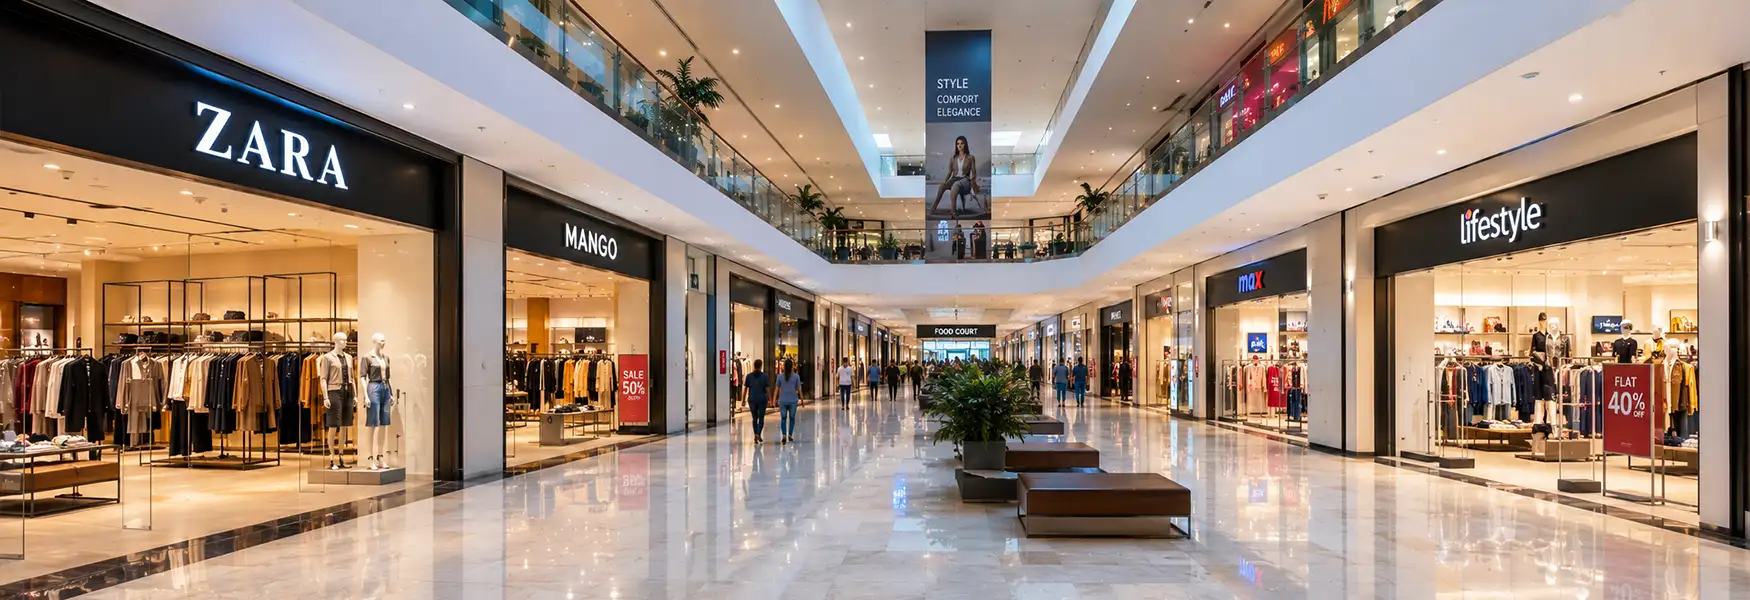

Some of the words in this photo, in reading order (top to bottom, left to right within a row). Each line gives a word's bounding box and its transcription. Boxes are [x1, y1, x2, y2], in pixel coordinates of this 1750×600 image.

[937, 78, 969, 89] STYLE
[936, 94, 979, 104] COMFORT
[937, 107, 981, 117] ELEGANCE
[195, 101, 349, 190] ZARA
[1461, 197, 1542, 244] lifestyle
[565, 222, 618, 260] MANGO
[1238, 270, 1263, 293] max
[623, 370, 644, 380] SALE
[622, 380, 646, 395] 50%
[1614, 376, 1637, 388] FLAT
[1607, 391, 1645, 416] 40%
[1633, 410, 1645, 418] OFF
